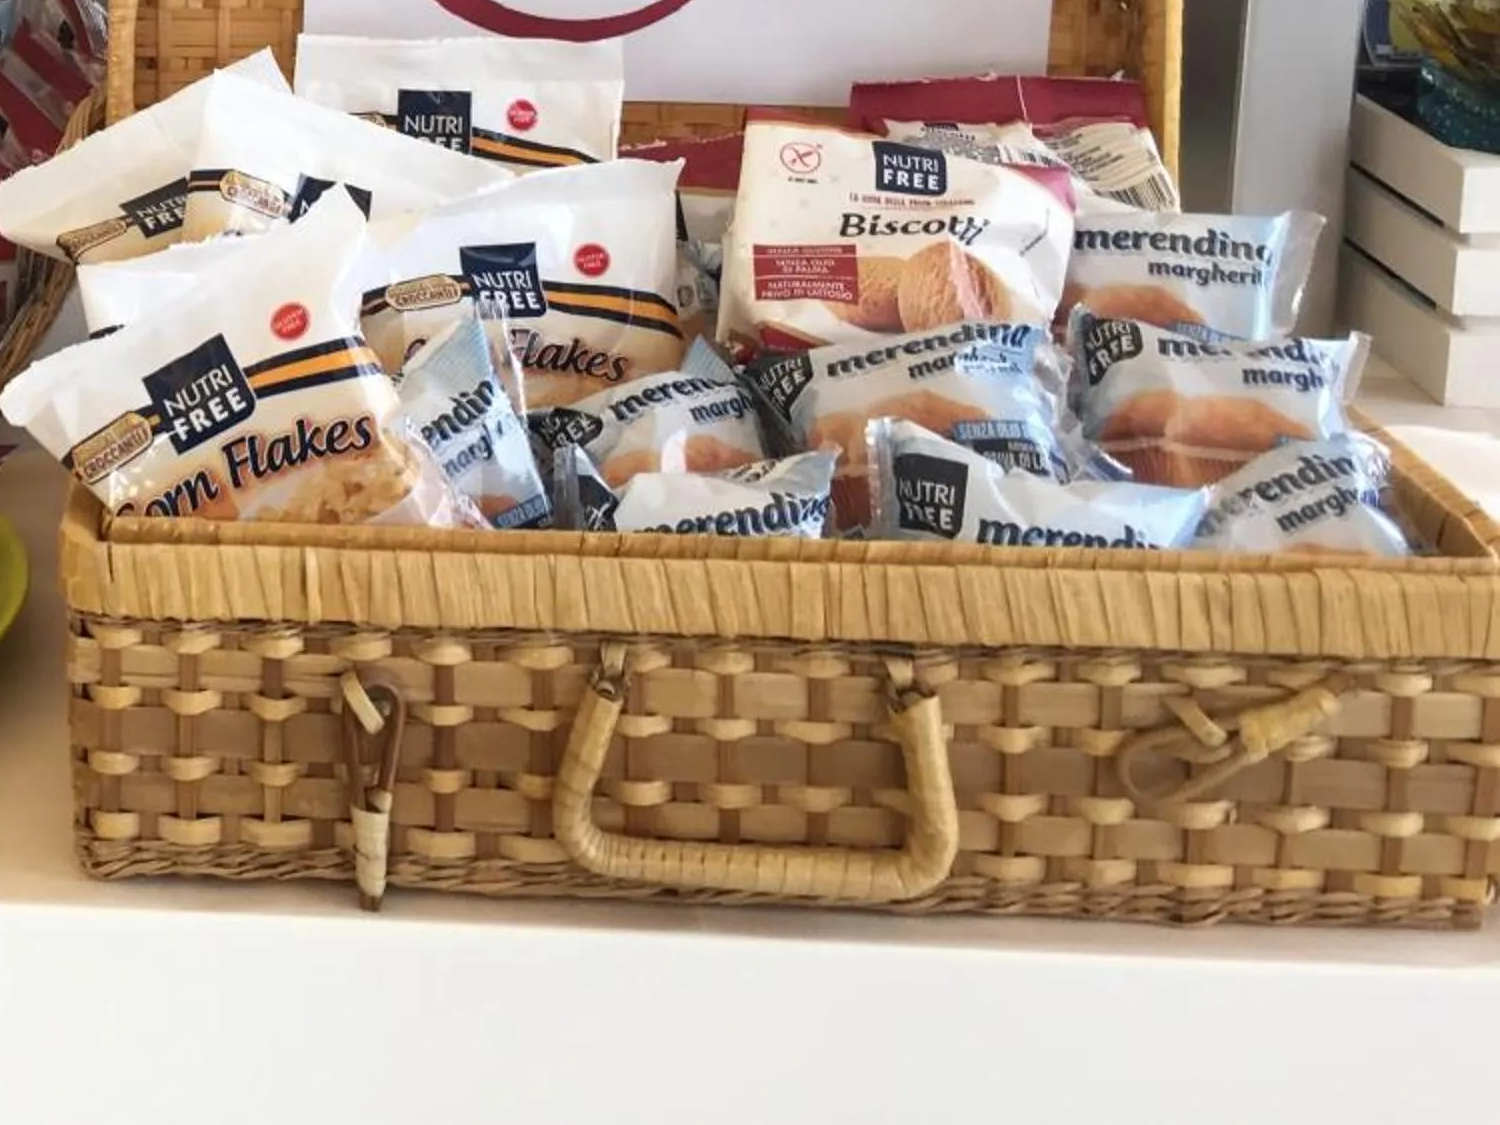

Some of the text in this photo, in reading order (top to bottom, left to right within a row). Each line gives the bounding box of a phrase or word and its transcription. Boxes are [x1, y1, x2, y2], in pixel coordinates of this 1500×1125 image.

[402, 114, 464, 135] NUTRI
[883, 153, 940, 174] NUTRI
[883, 171, 940, 192] FREE
[137, 192, 188, 219] NUTR
[839, 212, 991, 247] Biscotti
[1074, 227, 1273, 267] merendina
[470, 269, 533, 292] NUTRI
[1147, 259, 1265, 287] margherit
[478, 289, 542, 312] FREE
[827, 323, 1032, 378] merendina
[161, 363, 235, 419] NUTRI
[1242, 366, 1324, 393] margh
[173, 386, 249, 444] FREE
[690, 390, 753, 423] margh
[221, 414, 373, 489] Flakes
[1195, 452, 1355, 539] merendin
